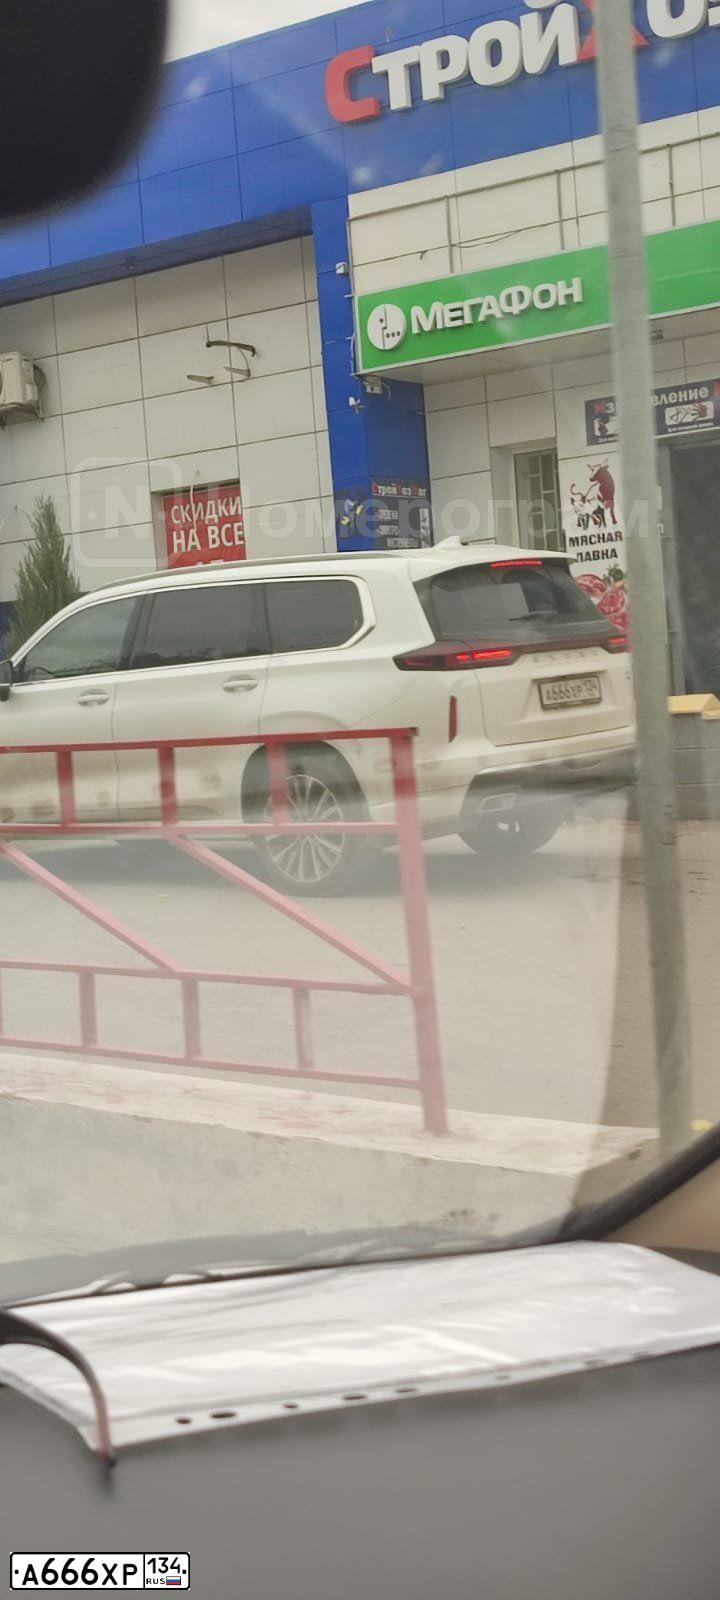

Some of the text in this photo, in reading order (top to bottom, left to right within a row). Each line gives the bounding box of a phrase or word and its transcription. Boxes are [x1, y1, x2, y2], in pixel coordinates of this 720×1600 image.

[170, 495, 243, 525] СКИДКИ
[172, 521, 246, 553] НА ВСЕ
[568, 530, 623, 547] МЯСНАЯ
[576, 548, 618, 563] ЛАВКА
